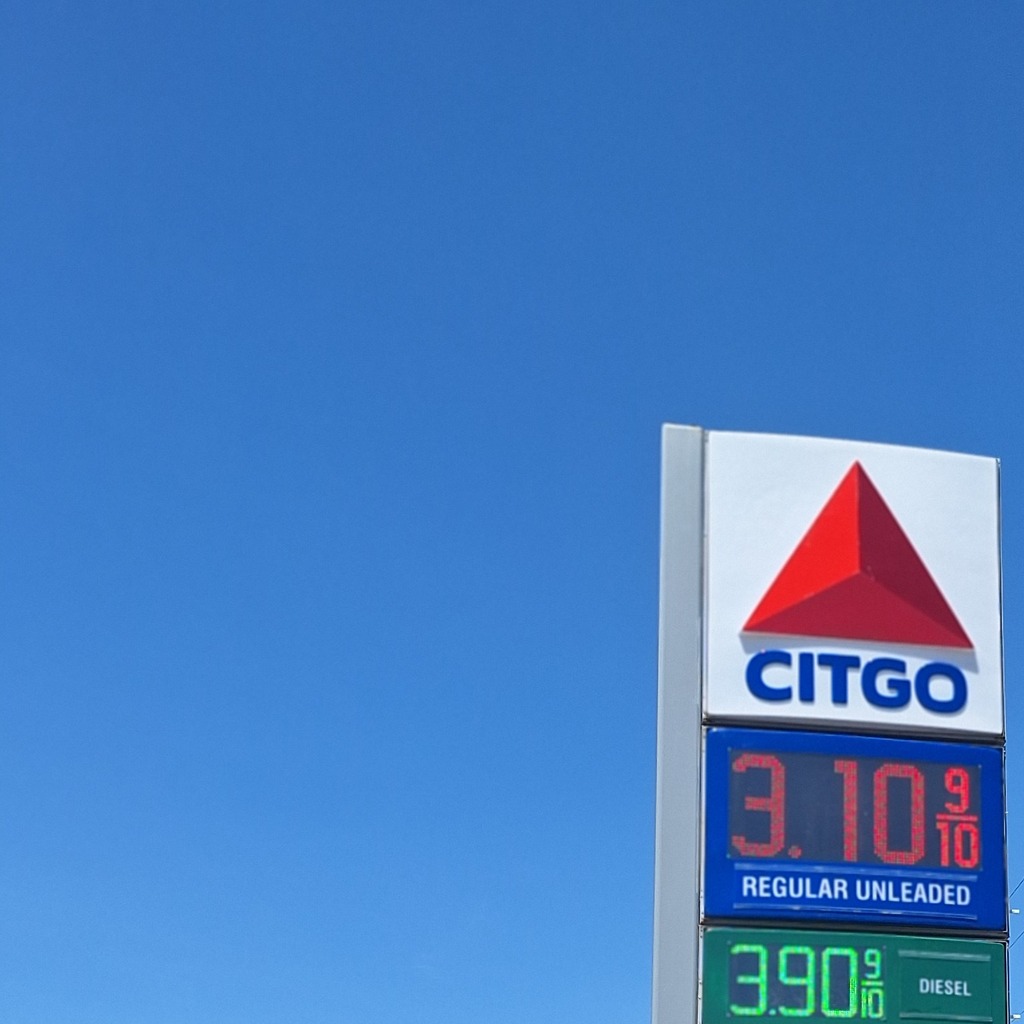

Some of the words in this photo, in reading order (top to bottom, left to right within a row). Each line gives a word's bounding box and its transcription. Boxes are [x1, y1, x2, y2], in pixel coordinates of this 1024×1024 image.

[745, 650, 968, 713] CITGO
[944, 767, 969, 814] 9
[936, 822, 980, 868] 10
[742, 876, 848, 900] REGULAR
[856, 880, 971, 906] UNLEADED
[730, 944, 858, 1016] 3.90
[863, 948, 882, 979] 9
[861, 988, 884, 1018] 10
[919, 978, 972, 996] DIESEL
